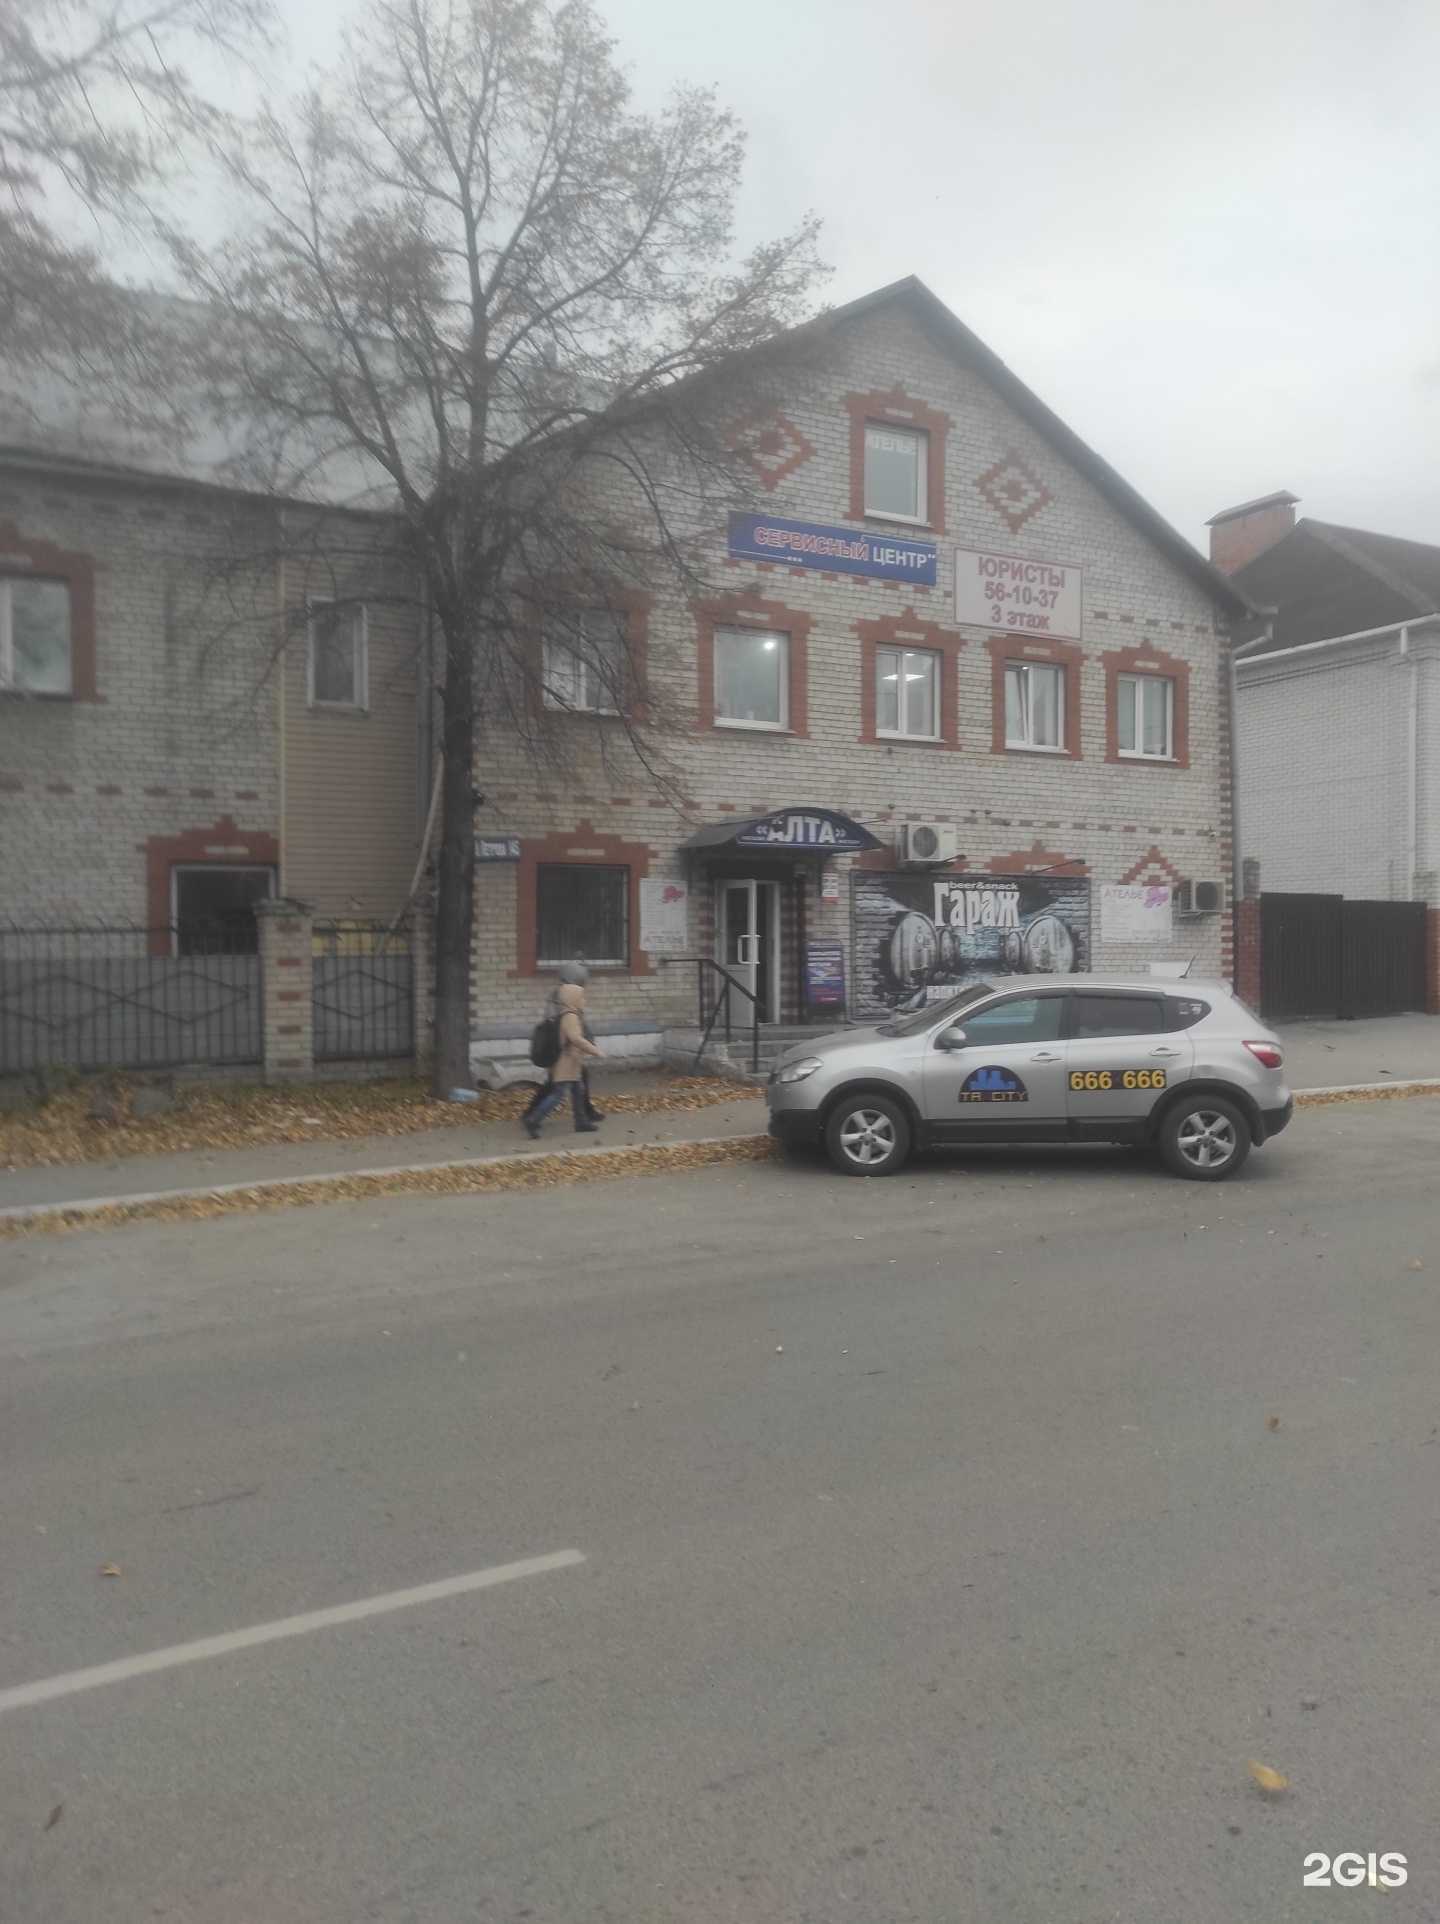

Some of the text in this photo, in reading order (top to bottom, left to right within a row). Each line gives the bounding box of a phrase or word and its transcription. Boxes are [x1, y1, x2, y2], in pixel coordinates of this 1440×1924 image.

[754, 526, 869, 561] СЕРВИСНЫЙ
[976, 556, 1065, 589] ЮРИСТЫ
[984, 581, 1058, 609] 56-10-37
[991, 604, 1049, 630] 3 этаж
[934, 882, 1020, 935] Гараж
[1071, 1070, 1166, 1090] 666 666
